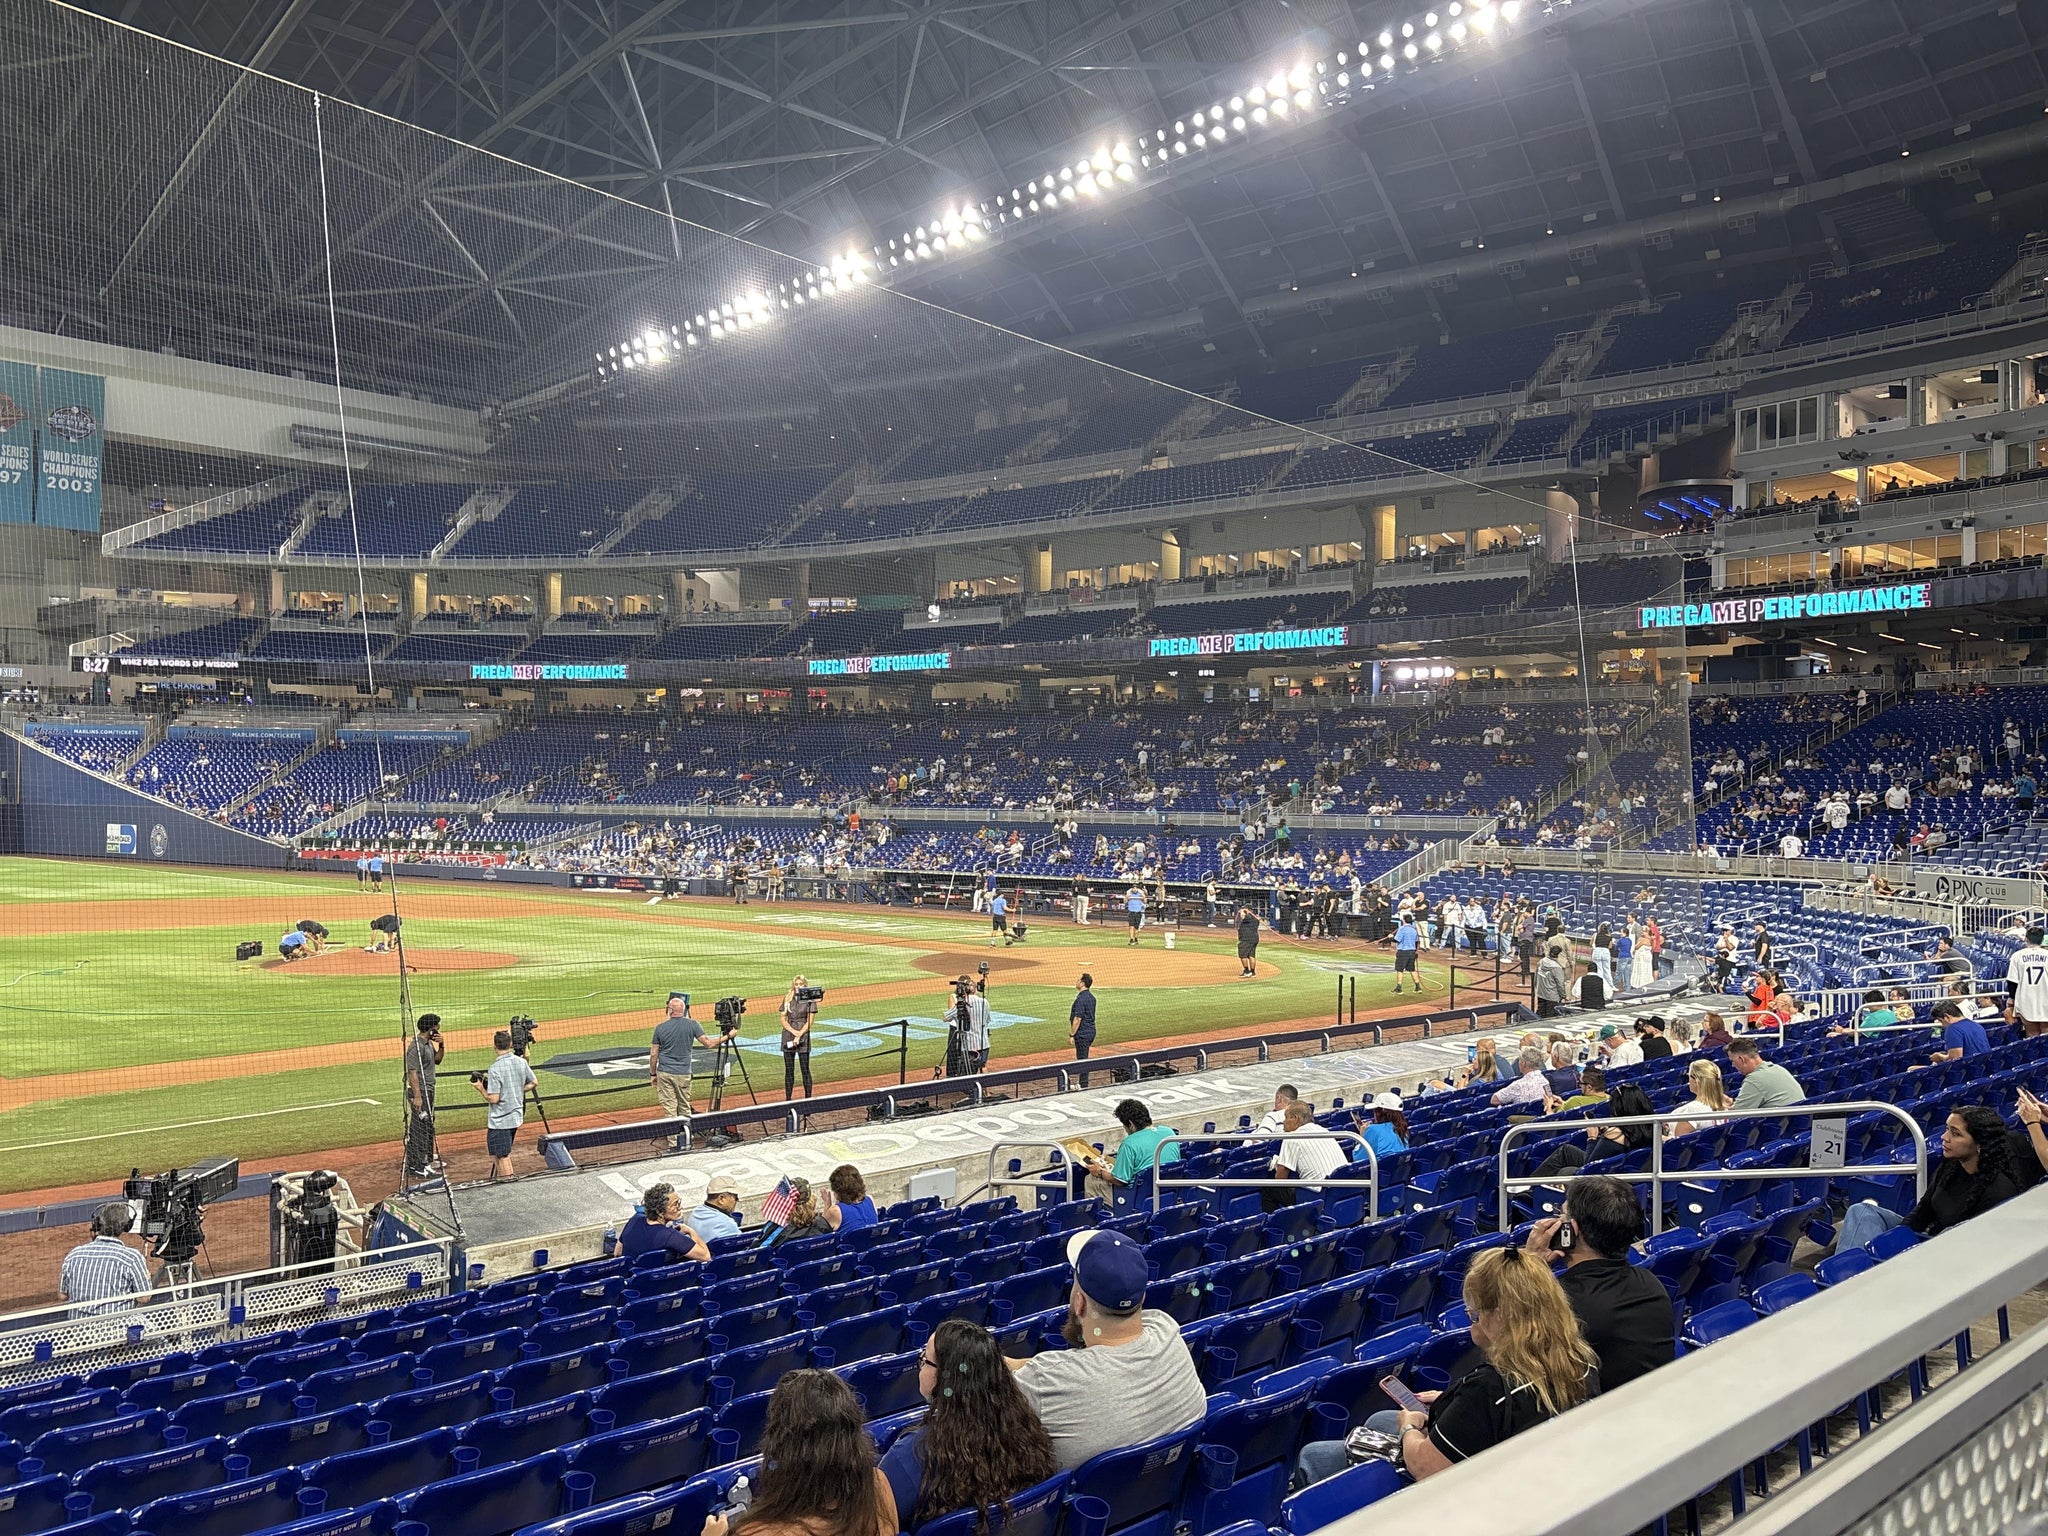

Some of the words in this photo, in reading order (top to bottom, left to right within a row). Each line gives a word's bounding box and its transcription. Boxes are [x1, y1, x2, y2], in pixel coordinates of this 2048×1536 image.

[1, 444, 29, 459] SERIES
[43, 449, 70, 464] WORLD
[71, 453, 98, 468] SERIES
[42, 461, 98, 480] CHAMPIONS
[46, 476, 93, 493] 2003
[1637, 600, 1746, 629] PREGAME
[1749, 583, 1932, 622] PERFORMANCE
[1148, 634, 1222, 657] PREGAME
[1224, 626, 1349, 653] PERFORMANCE
[82, 658, 109, 672] 6:27
[160, 660, 191, 668] WORDS
[205, 661, 239, 669] WISDOM
[471, 665, 532, 679] PREGAME
[534, 664, 628, 679] PERFORMANCE
[807, 656, 863, 675] PREGAME
[864, 652, 952, 673] PERFORMANCE
[231, 731, 301, 739] MARLINS.COM/TICKETS
[1952, 879, 1983, 899] PNC
[1984, 887, 2007, 896] CLUB
[2021, 954, 2048, 963] OHTANI
[2025, 966, 2044, 986] 17
[1824, 1140, 1841, 1156] 21
[214, 1496, 230, 1506] SCAN
[238, 1491, 249, 1500] BET
[250, 1488, 263, 1497] NOW
